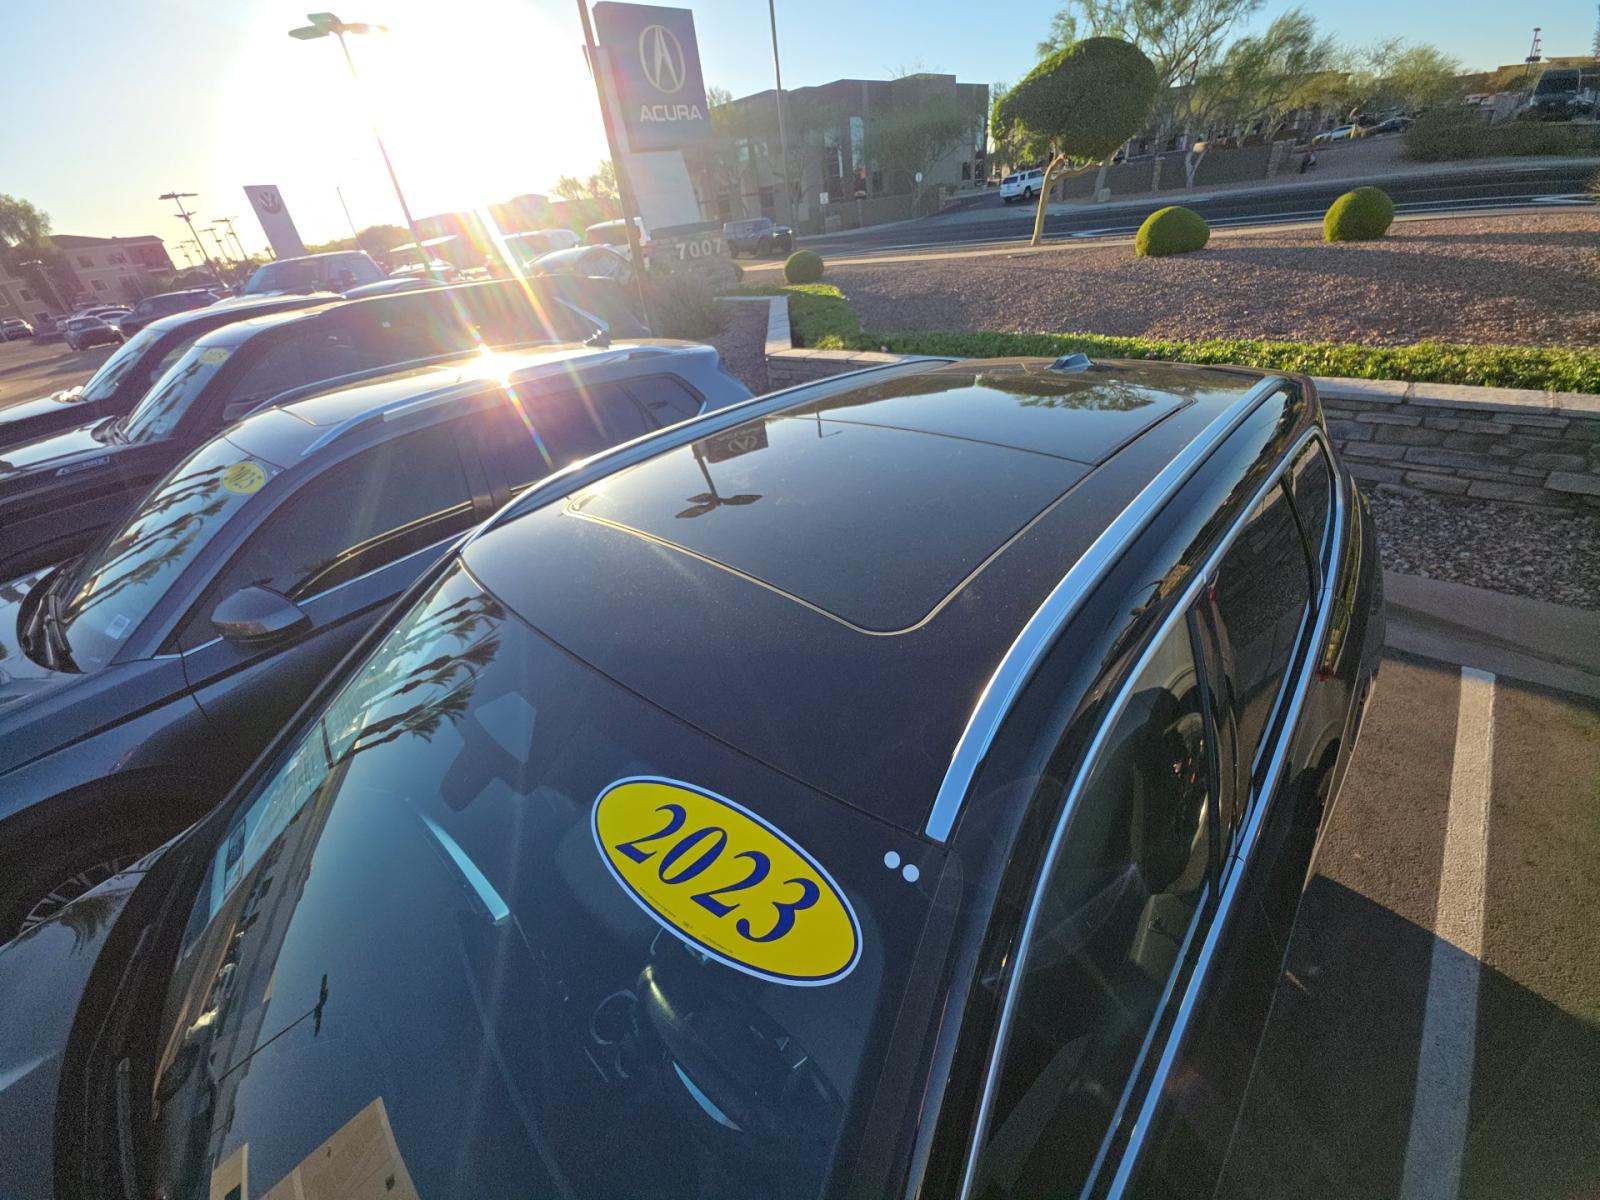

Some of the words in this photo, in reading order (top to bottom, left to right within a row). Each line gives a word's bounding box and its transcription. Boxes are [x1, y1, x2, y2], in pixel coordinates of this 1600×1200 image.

[640, 104, 703, 122] ACURA
[675, 238, 721, 260] 7007
[615, 803, 821, 943] 2023
